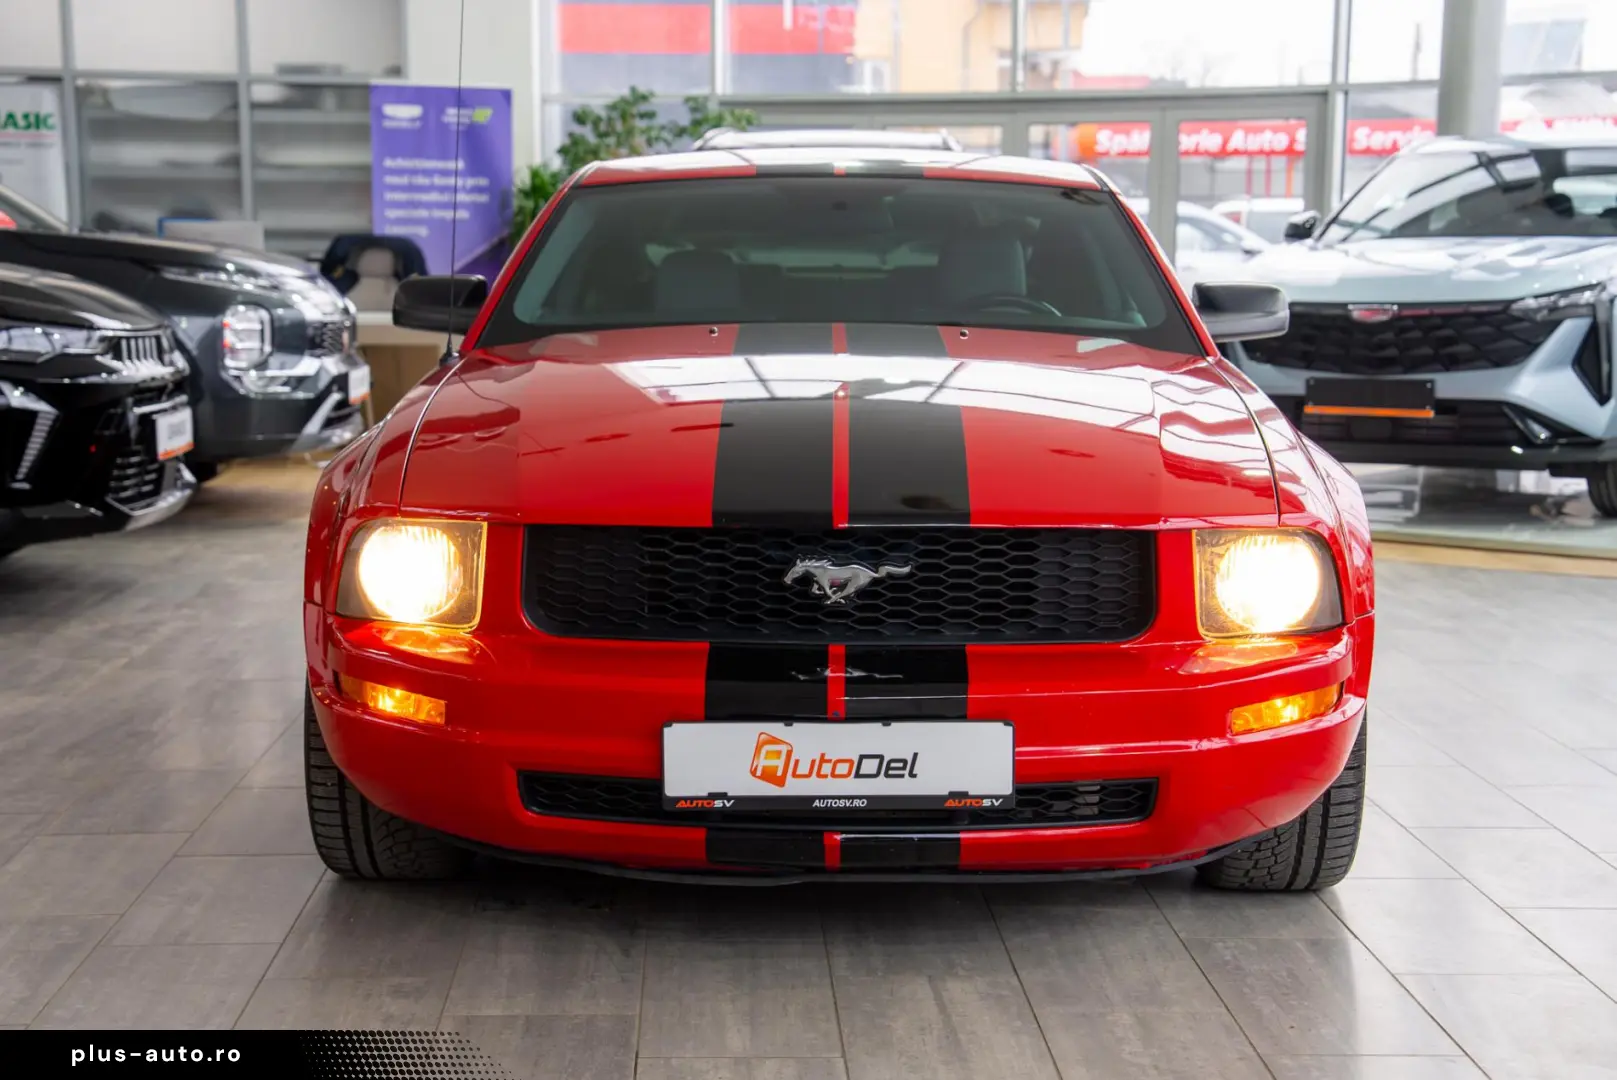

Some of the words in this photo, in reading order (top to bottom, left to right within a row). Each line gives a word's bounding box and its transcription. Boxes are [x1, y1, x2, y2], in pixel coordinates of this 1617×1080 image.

[0, 111, 56, 131] ASIC
[1226, 128, 1290, 153] Auto
[754, 744, 919, 780] AutoDel
[675, 799, 735, 808] AUTOSV
[812, 799, 867, 808] AUTOSV.RO
[944, 798, 1004, 808] AUTOSV
